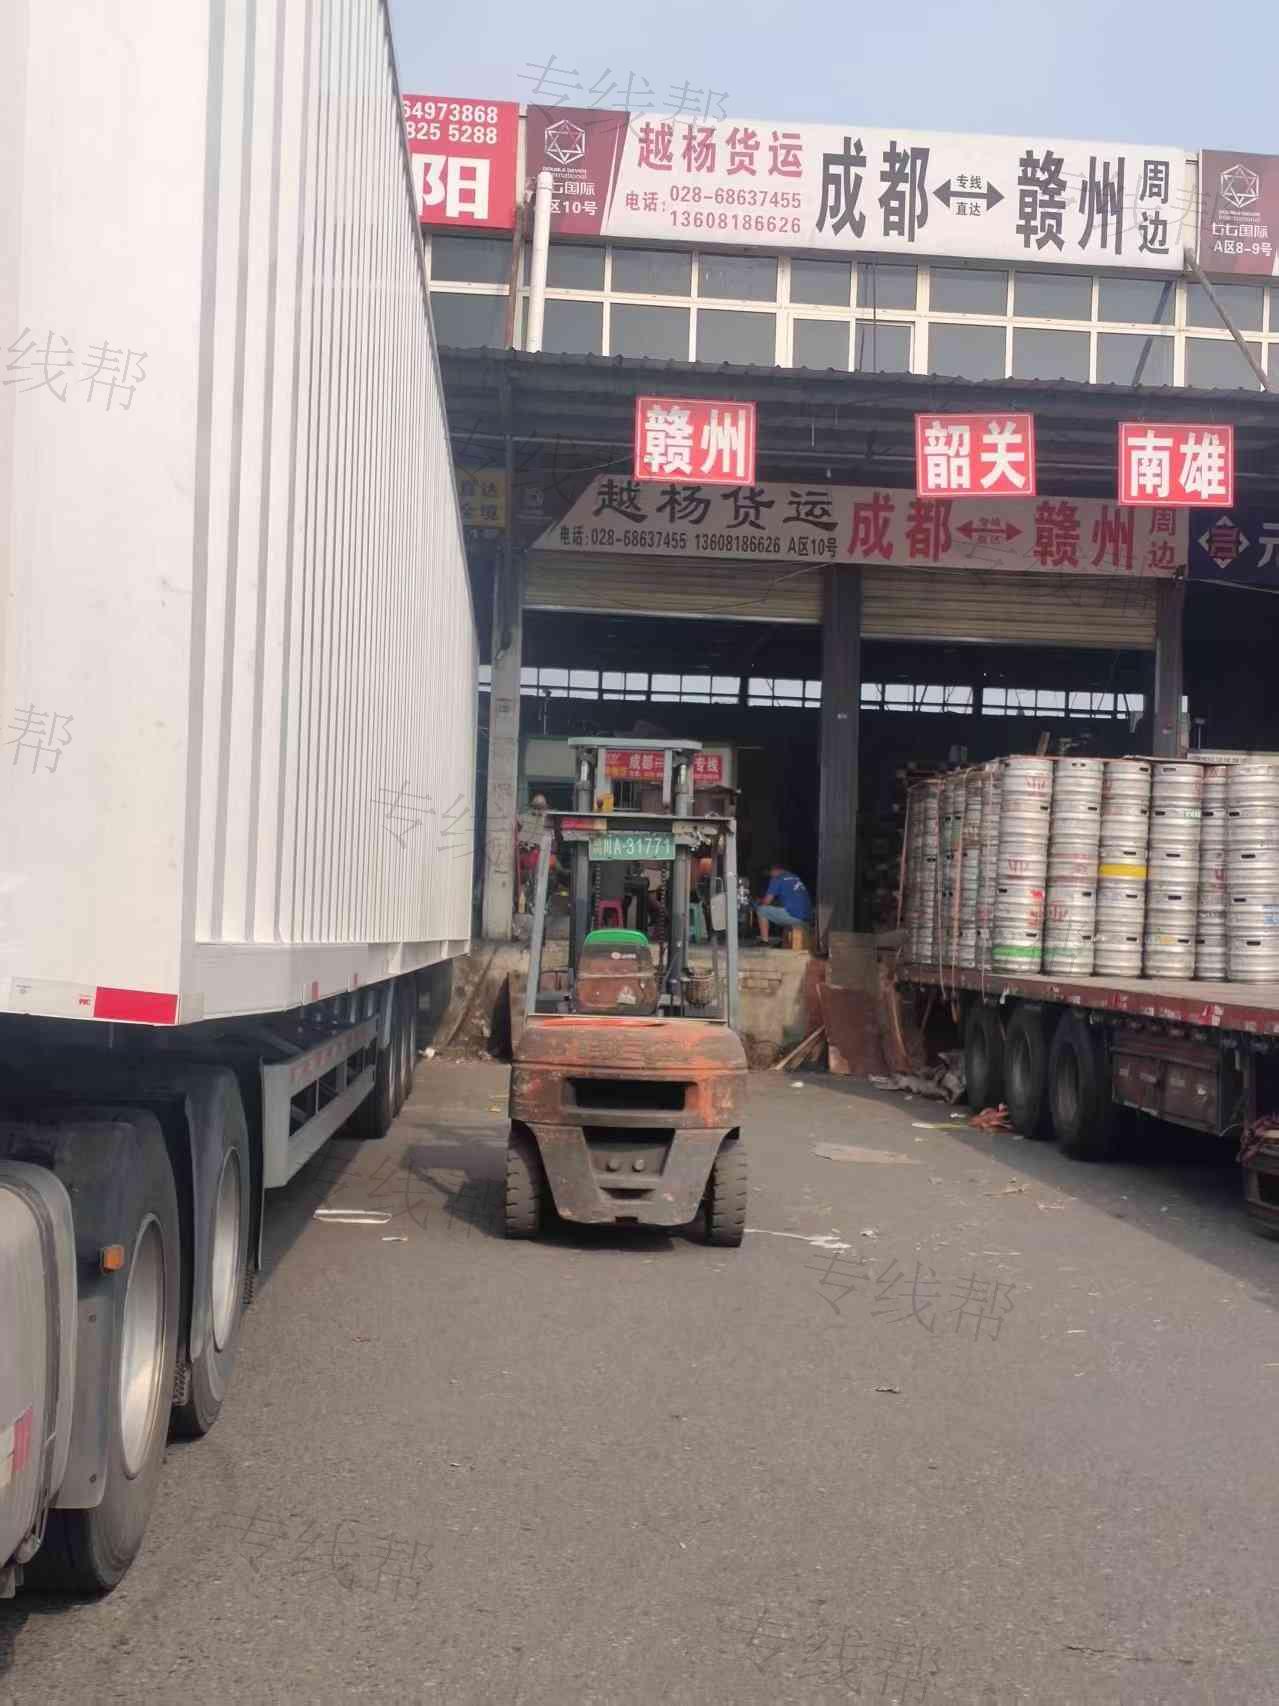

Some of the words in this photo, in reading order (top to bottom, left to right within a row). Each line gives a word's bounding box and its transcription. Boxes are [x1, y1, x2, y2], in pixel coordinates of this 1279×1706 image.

[448, 125, 498, 145] 5288
[637, 121, 803, 178] 越杨货运
[550, 200, 599, 216] 区10号
[669, 185, 801, 210] 028-68637455
[815, 136, 931, 243] 成都
[954, 202, 982, 217] 直达
[955, 174, 983, 190] 专线
[1014, 149, 1127, 256] 赣州
[1137, 159, 1171, 255] 周边
[669, 210, 801, 234] 13608186626
[643, 404, 746, 477] 赣州
[923, 420, 1027, 490] 韶关
[1127, 429, 1228, 500] 南雄
[593, 478, 839, 532] 越杨货运
[847, 491, 953, 561] 成都
[1033, 500, 1136, 570] 赣州
[695, 532, 781, 554] 13608186626
[787, 536, 839, 559] A区10号
[1146, 506, 1177, 569] 周边
